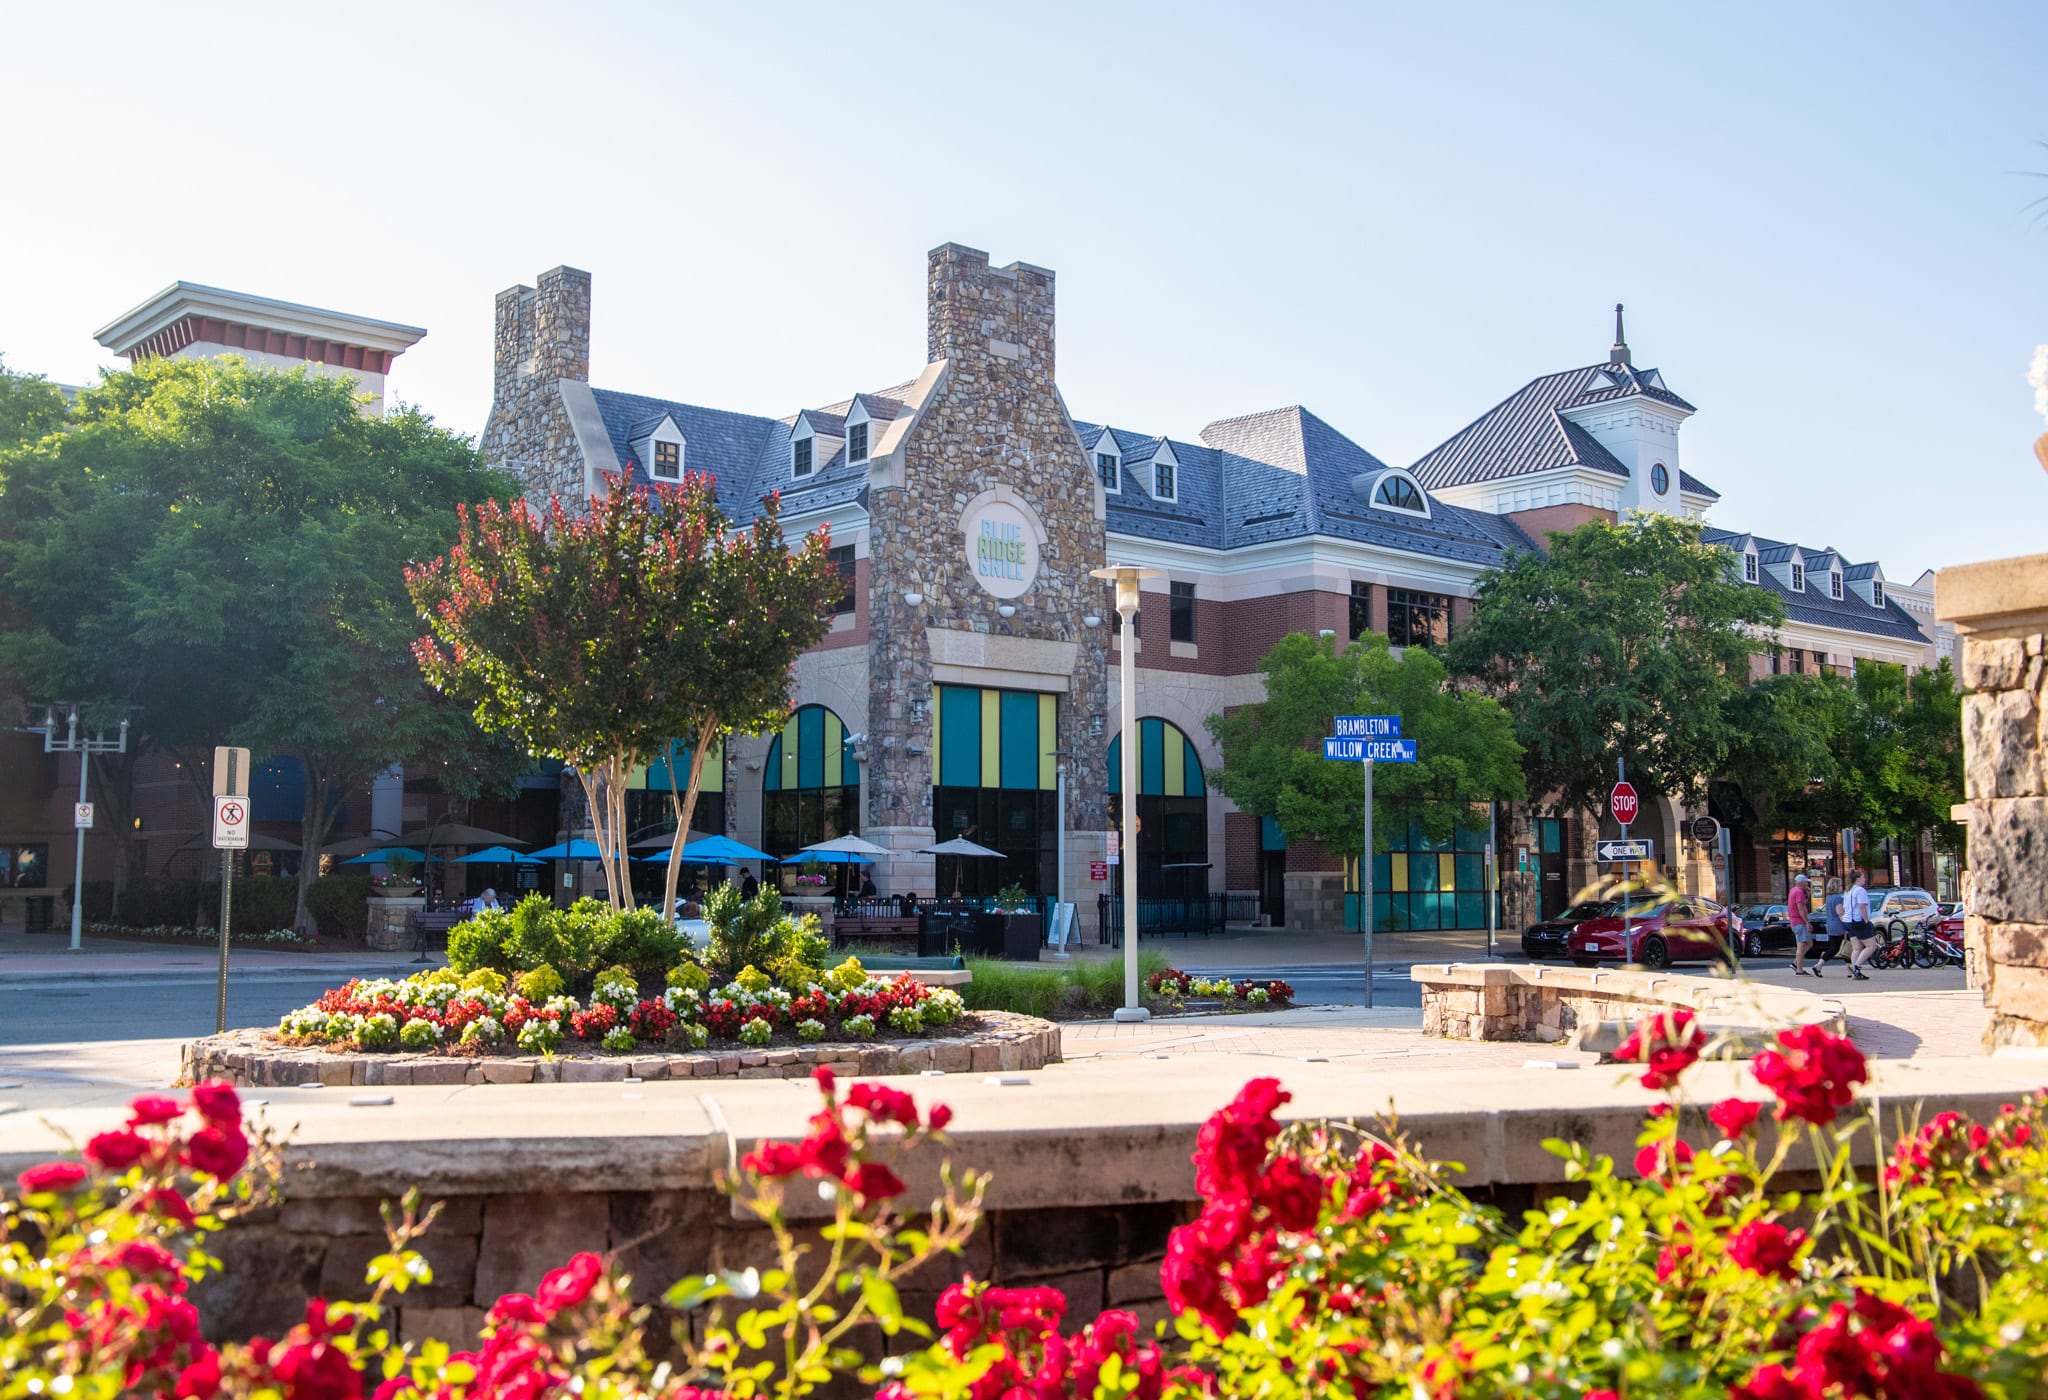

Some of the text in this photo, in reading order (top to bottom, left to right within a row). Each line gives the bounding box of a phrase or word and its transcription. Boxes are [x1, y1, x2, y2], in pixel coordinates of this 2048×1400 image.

[982, 519, 1020, 540] BLUE
[977, 536, 1026, 564] RIDGE
[978, 557, 1024, 581] GRILL
[1337, 719, 1398, 736] BRAMBLETON PL
[1326, 741, 1414, 759] WILLOW CREEK WAY
[1613, 796, 1636, 811] STOP
[1612, 846, 1644, 854] ONE WAY
